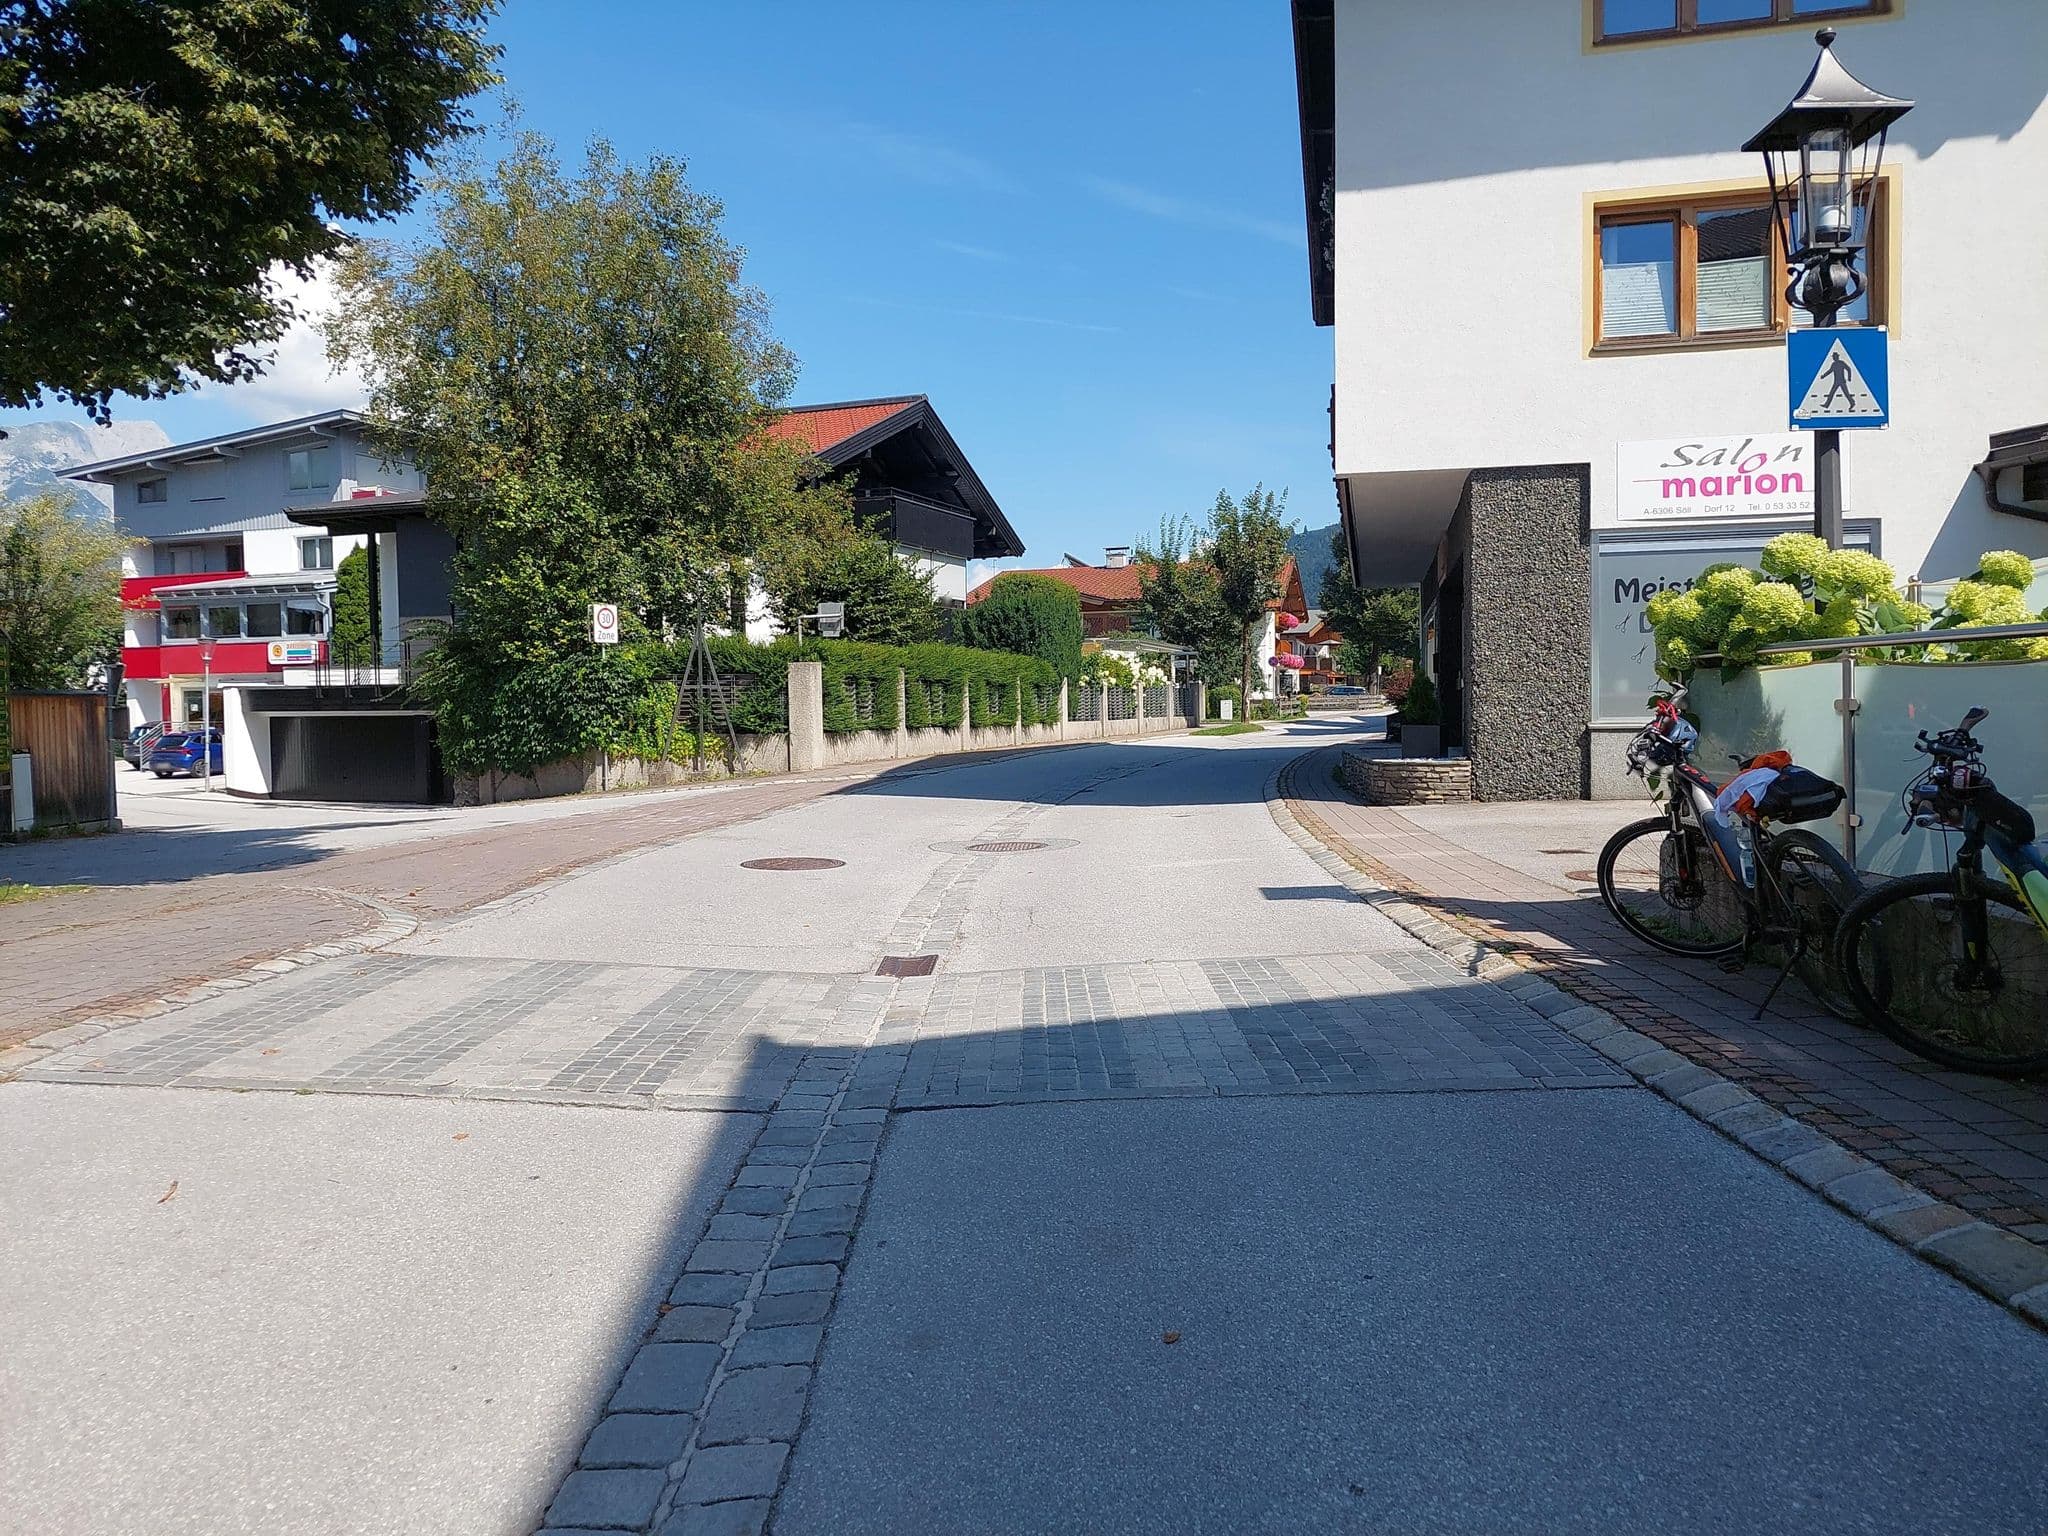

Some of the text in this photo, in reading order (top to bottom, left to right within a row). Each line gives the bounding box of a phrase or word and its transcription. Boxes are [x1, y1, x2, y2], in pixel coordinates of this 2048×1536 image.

[1660, 438, 1802, 474] Salon
[1662, 473, 1803, 498] marion
[1704, 504, 1722, 513] Dorf
[1725, 504, 1736, 512] 12
[601, 613, 611, 624] 30
[598, 630, 615, 640] Zone
